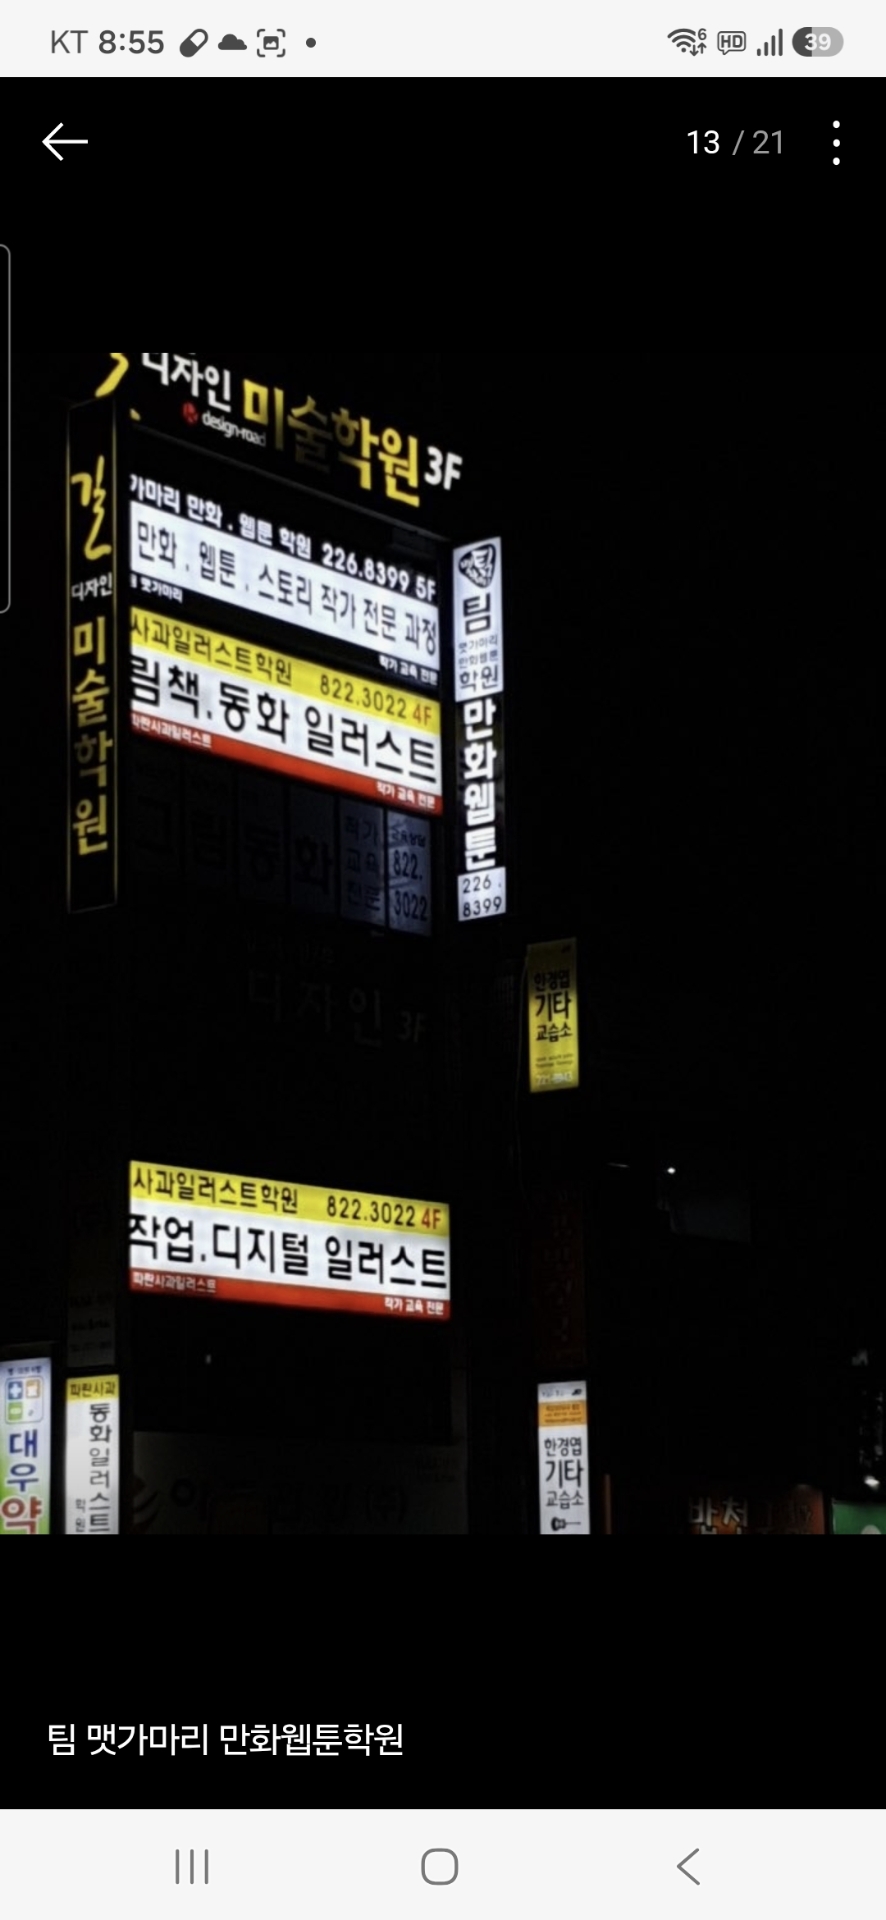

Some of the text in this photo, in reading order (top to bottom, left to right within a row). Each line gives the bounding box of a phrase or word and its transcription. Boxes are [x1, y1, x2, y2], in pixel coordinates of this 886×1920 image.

[243, 378, 420, 507] 미술학원
[424, 446, 463, 491] 3F
[71, 454, 112, 561] 길
[186, 494, 223, 529] 만화
[239, 512, 273, 547] 웹툰
[279, 527, 312, 561] 학원
[321, 542, 410, 593] 226.8399
[415, 575, 437, 602] 5F
[71, 571, 113, 602] 디자인
[137, 520, 177, 570] 만화
[199, 541, 236, 589] 웹툰
[258, 563, 313, 616] 스토리
[321, 583, 356, 630] 작가
[363, 598, 397, 642] 전문
[405, 612, 437, 656] 과정
[462, 592, 492, 636] 팀
[131, 614, 433, 727] 사과일러스트학원 822.3022 4F
[458, 664, 499, 693] 학원
[72, 616, 114, 856] 미술학원
[304, 705, 437, 784] 일러스트
[463, 697, 497, 872] 만화웹툰
[393, 850, 424, 880] 822.
[393, 890, 428, 922] 3022
[462, 896, 503, 919] 8399
[534, 990, 572, 1022] 기타
[535, 1021, 573, 1043] 교습소
[132, 1166, 442, 1231] 사과일러스트학원 822.3022 4F
[325, 1234, 448, 1290] 일러스트
[69, 1380, 117, 1398] 파란사과
[88, 1402, 113, 1534] 동화일러스트
[543, 1436, 583, 1458] 한경엽
[545, 1458, 585, 1489] 기타
[545, 1489, 585, 1510] 교습소
